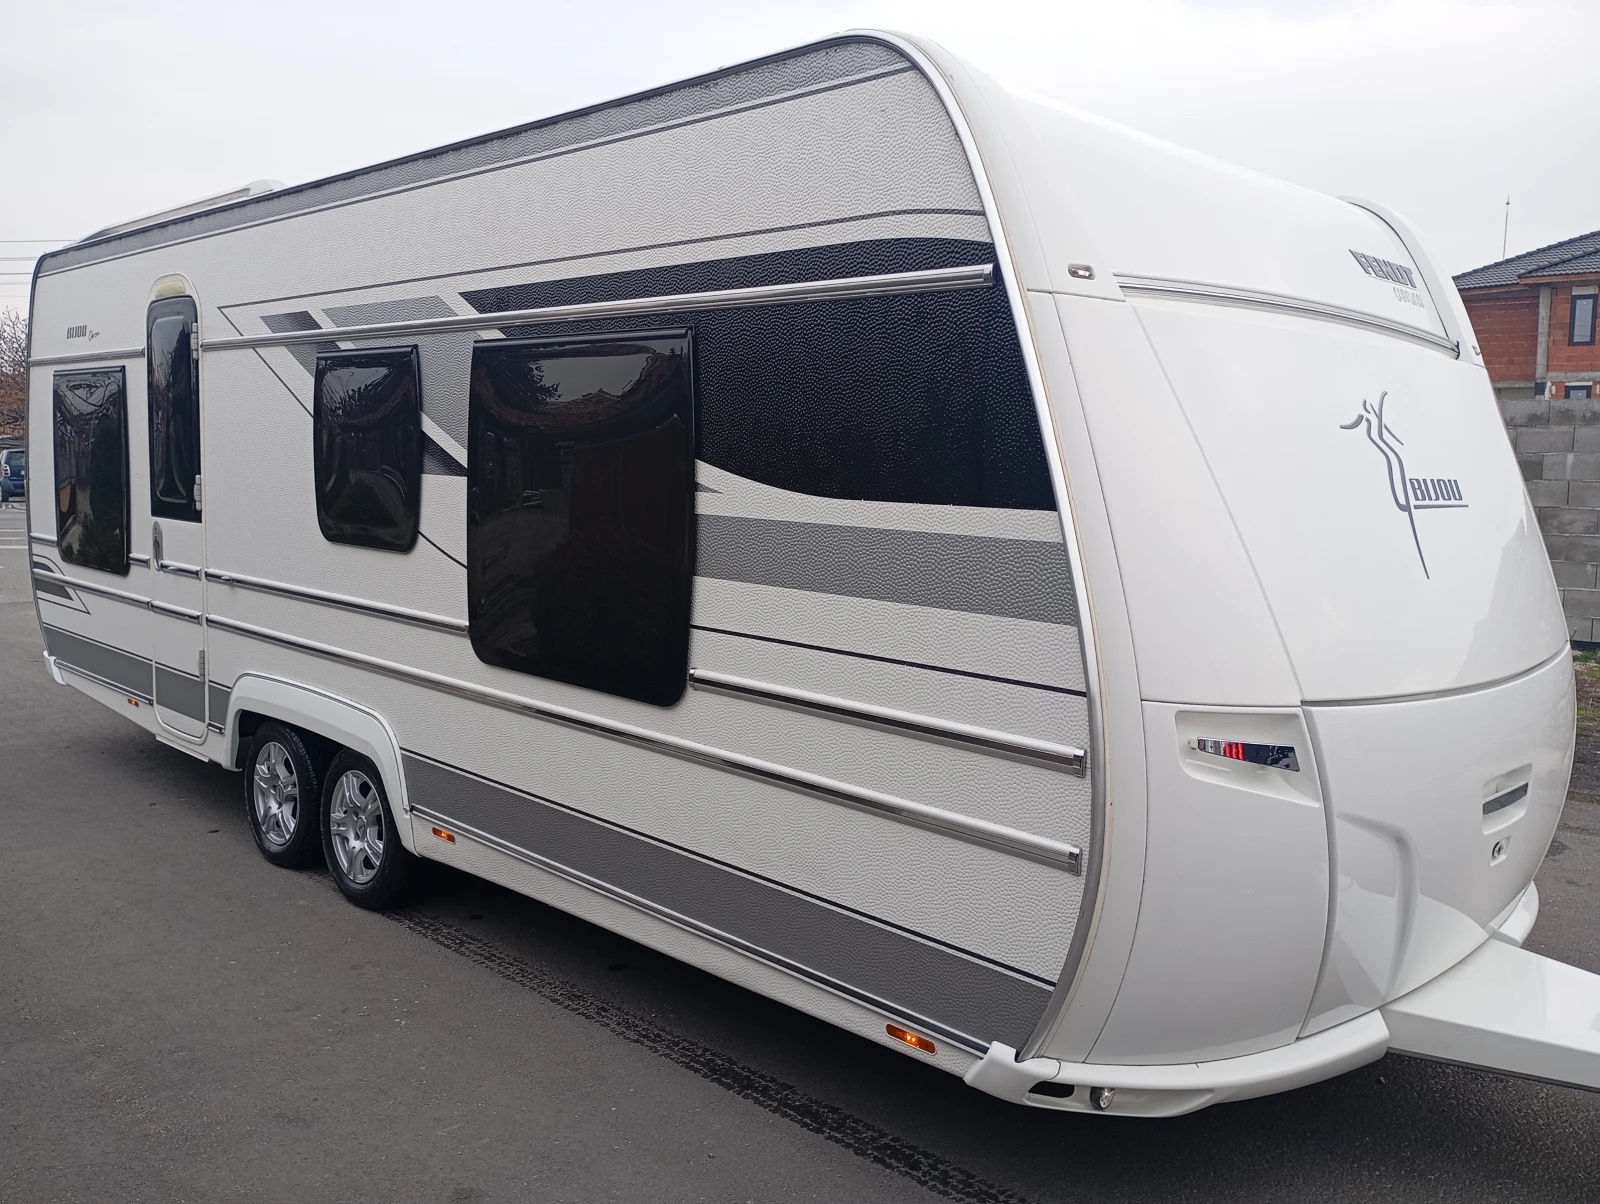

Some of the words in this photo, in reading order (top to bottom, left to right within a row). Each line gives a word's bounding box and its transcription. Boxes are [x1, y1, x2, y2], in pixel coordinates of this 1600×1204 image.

[1349, 249, 1417, 288] FENDT
[67, 325, 87, 339] BIJOU
[1409, 478, 1463, 501] BIJOU
